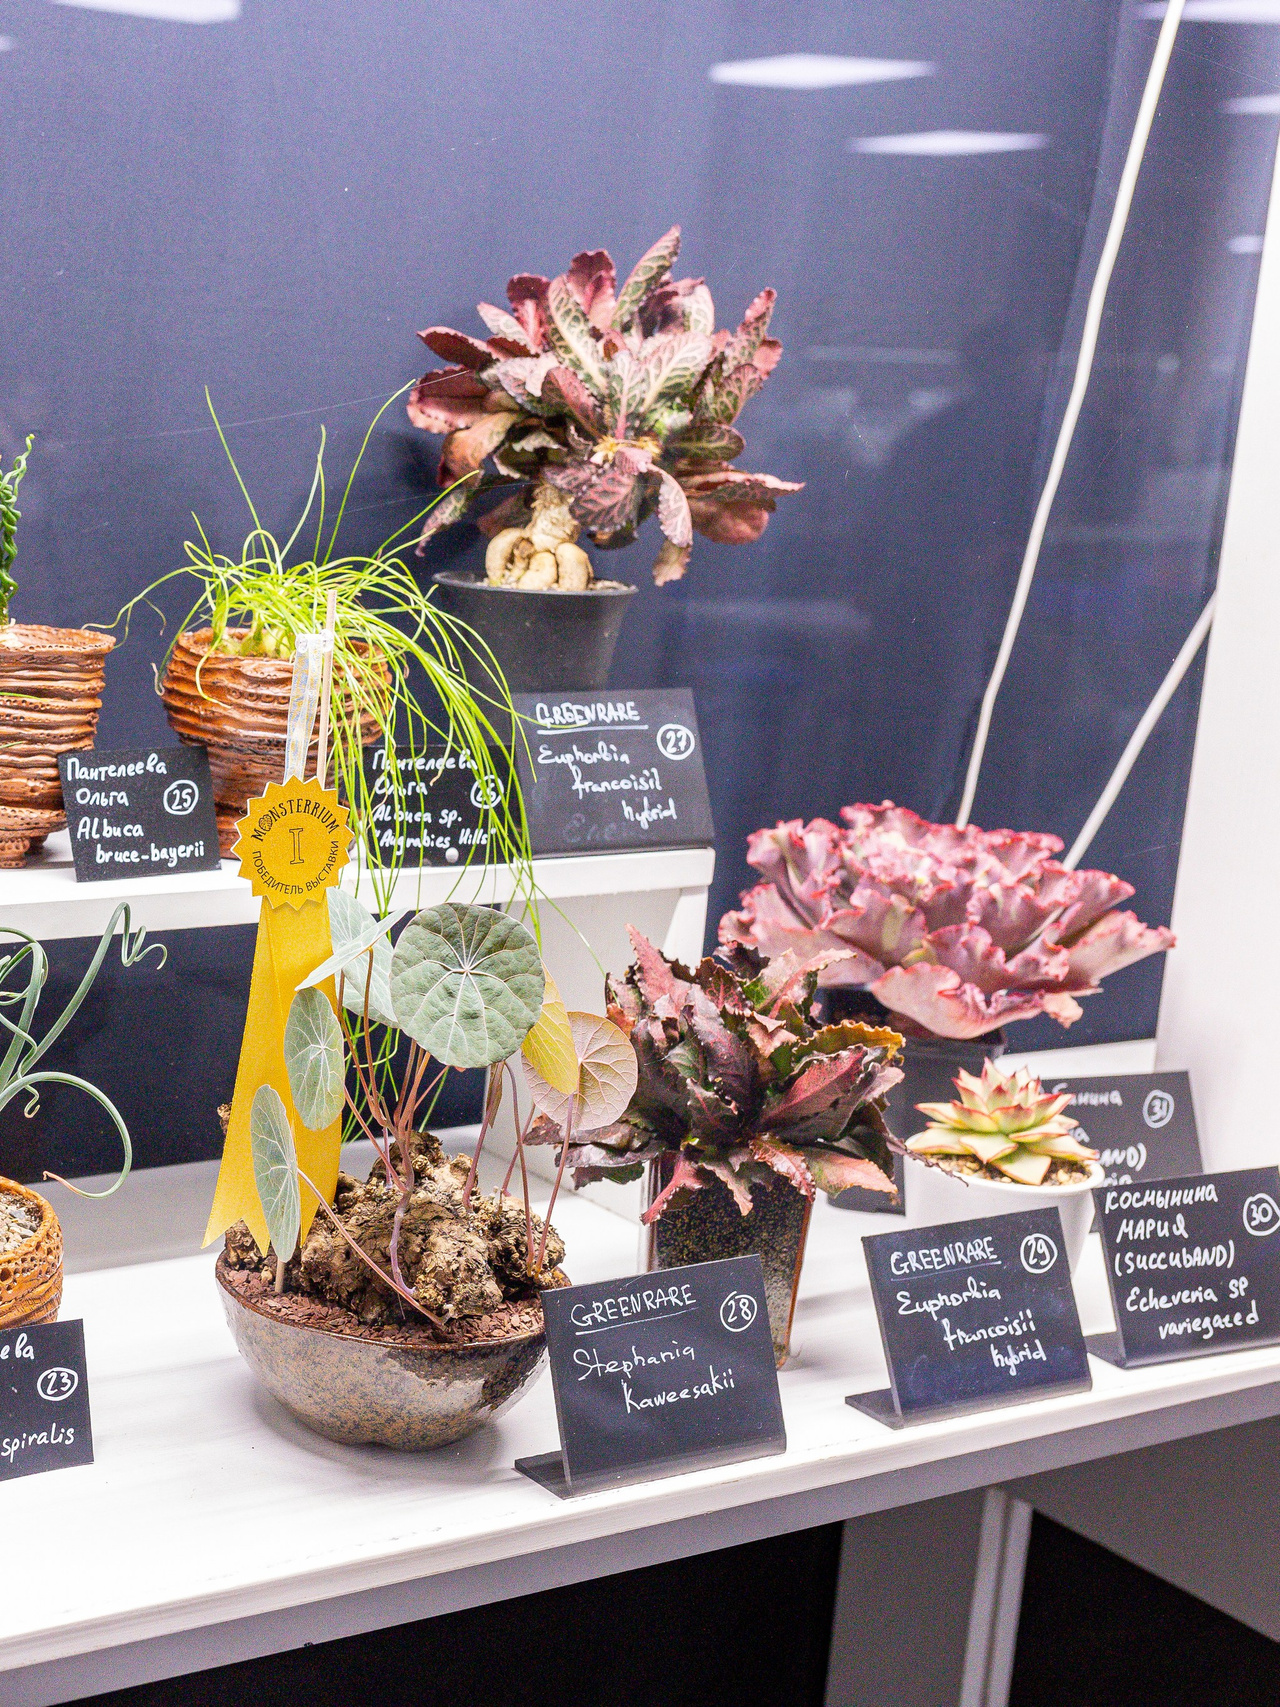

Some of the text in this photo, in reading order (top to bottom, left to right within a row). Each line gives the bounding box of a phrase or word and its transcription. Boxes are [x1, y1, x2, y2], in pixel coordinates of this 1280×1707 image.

[535, 701, 640, 729] GREENRARE
[665, 730, 687, 753] 27
[67, 753, 167, 781] Пантелеева
[76, 787, 129, 807] Ольга
[172, 789, 193, 810] 25
[77, 816, 144, 840] Albuca
[251, 798, 340, 842] MONSTERRIUM
[439, 809, 462, 828] sp.
[96, 841, 205, 867] bruce-bayerii
[252, 840, 339, 895] ПОБЕДИТЕЛЬ ВЫСТАВКИ
[1250, 1203, 1273, 1226] 30
[890, 1236, 998, 1275] GREENRARE
[1027, 1238, 1051, 1266] 29
[570, 1284, 697, 1327] GREENRARE
[727, 1299, 752, 1323] 28
[897, 1276, 1001, 1321] Euphorbia
[1126, 1286, 1218, 1312] Echeveria
[1159, 1299, 1259, 1340] variegated
[573, 1341, 696, 1381] Stephania
[991, 1339, 1047, 1377] hybrid
[47, 1371, 71, 1395] 23
[1, 1423, 74, 1463] spiralis
